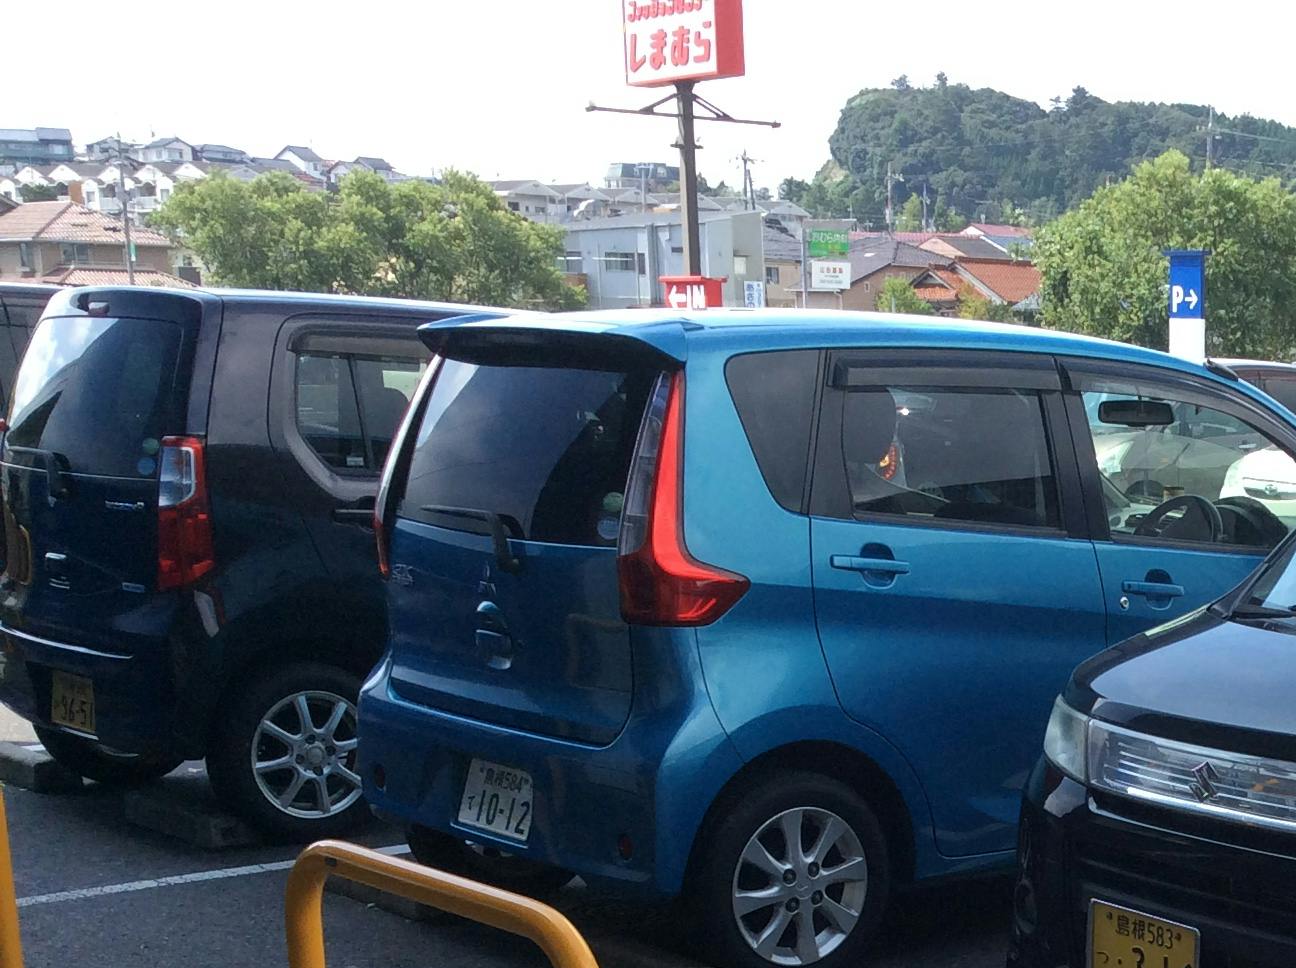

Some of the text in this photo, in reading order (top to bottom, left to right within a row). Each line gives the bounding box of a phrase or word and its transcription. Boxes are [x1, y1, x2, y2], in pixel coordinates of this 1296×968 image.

[629, 20, 712, 73] しまむら
[686, 284, 706, 311] IN
[1172, 285, 1184, 313] P
[476, 789, 530, 835] 10-12
